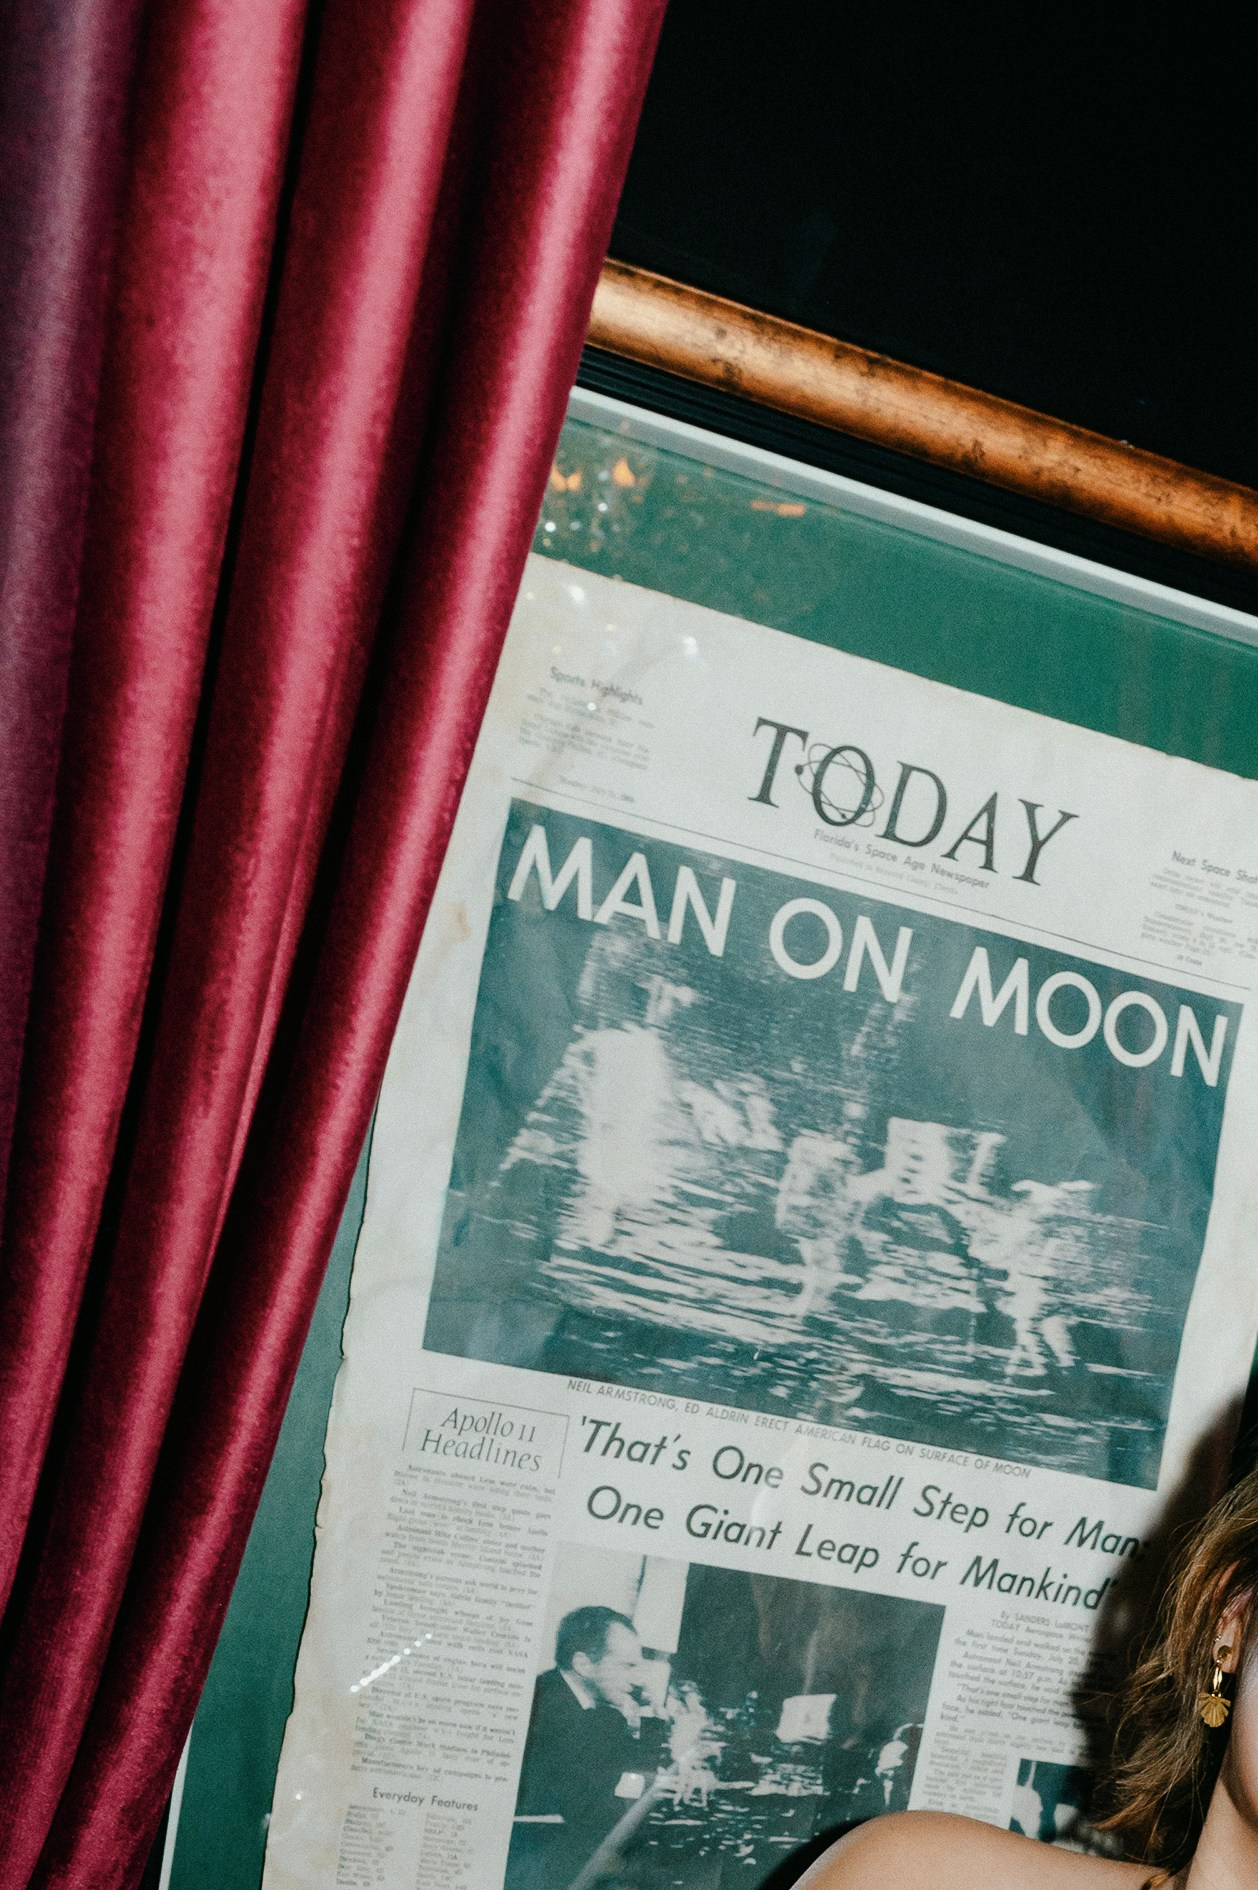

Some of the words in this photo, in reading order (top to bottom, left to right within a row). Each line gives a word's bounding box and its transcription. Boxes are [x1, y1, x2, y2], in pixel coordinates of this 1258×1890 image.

[550, 666, 584, 686] Sports
[591, 680, 641, 704] Highlights
[747, 716, 1079, 886] TODAY
[813, 828, 859, 851] Florida's
[864, 843, 897, 862] Space
[902, 855, 925, 871] Age
[930, 862, 989, 888] Newspaper
[1172, 850, 1195, 865] Next
[1201, 859, 1230, 876] Space
[1236, 869, 1257, 883] Shot
[507, 824, 736, 956] MAN
[768, 897, 913, 1003] ON
[949, 946, 1228, 1086] MOON
[420, 1428, 541, 1470] Headlines
[440, 1407, 514, 1443] Apollo
[567, 1380, 591, 1393] NEIL
[597, 1386, 677, 1412] ARMSTRONG,
[684, 1402, 698, 1413] ED
[706, 1407, 747, 1423] ALDRIN
[754, 1419, 788, 1429] ERECT
[794, 1424, 854, 1443] AMERICAN
[861, 1437, 889, 1450] FLAG
[896, 1446, 912, 1455] ON
[919, 1451, 967, 1465] SURFACE
[974, 1458, 988, 1469] OF
[994, 1462, 1029, 1477] MOON
[711, 1444, 783, 1488] One
[799, 1461, 904, 1510] Small
[912, 1484, 989, 1533] Step
[1004, 1501, 1054, 1540] for
[586, 1484, 664, 1530] One
[684, 1503, 783, 1550] Giant
[794, 1523, 880, 1574] Leap
[895, 1540, 948, 1580] for
[372, 1786, 424, 1806] Everyday
[430, 1794, 477, 1811] Features
